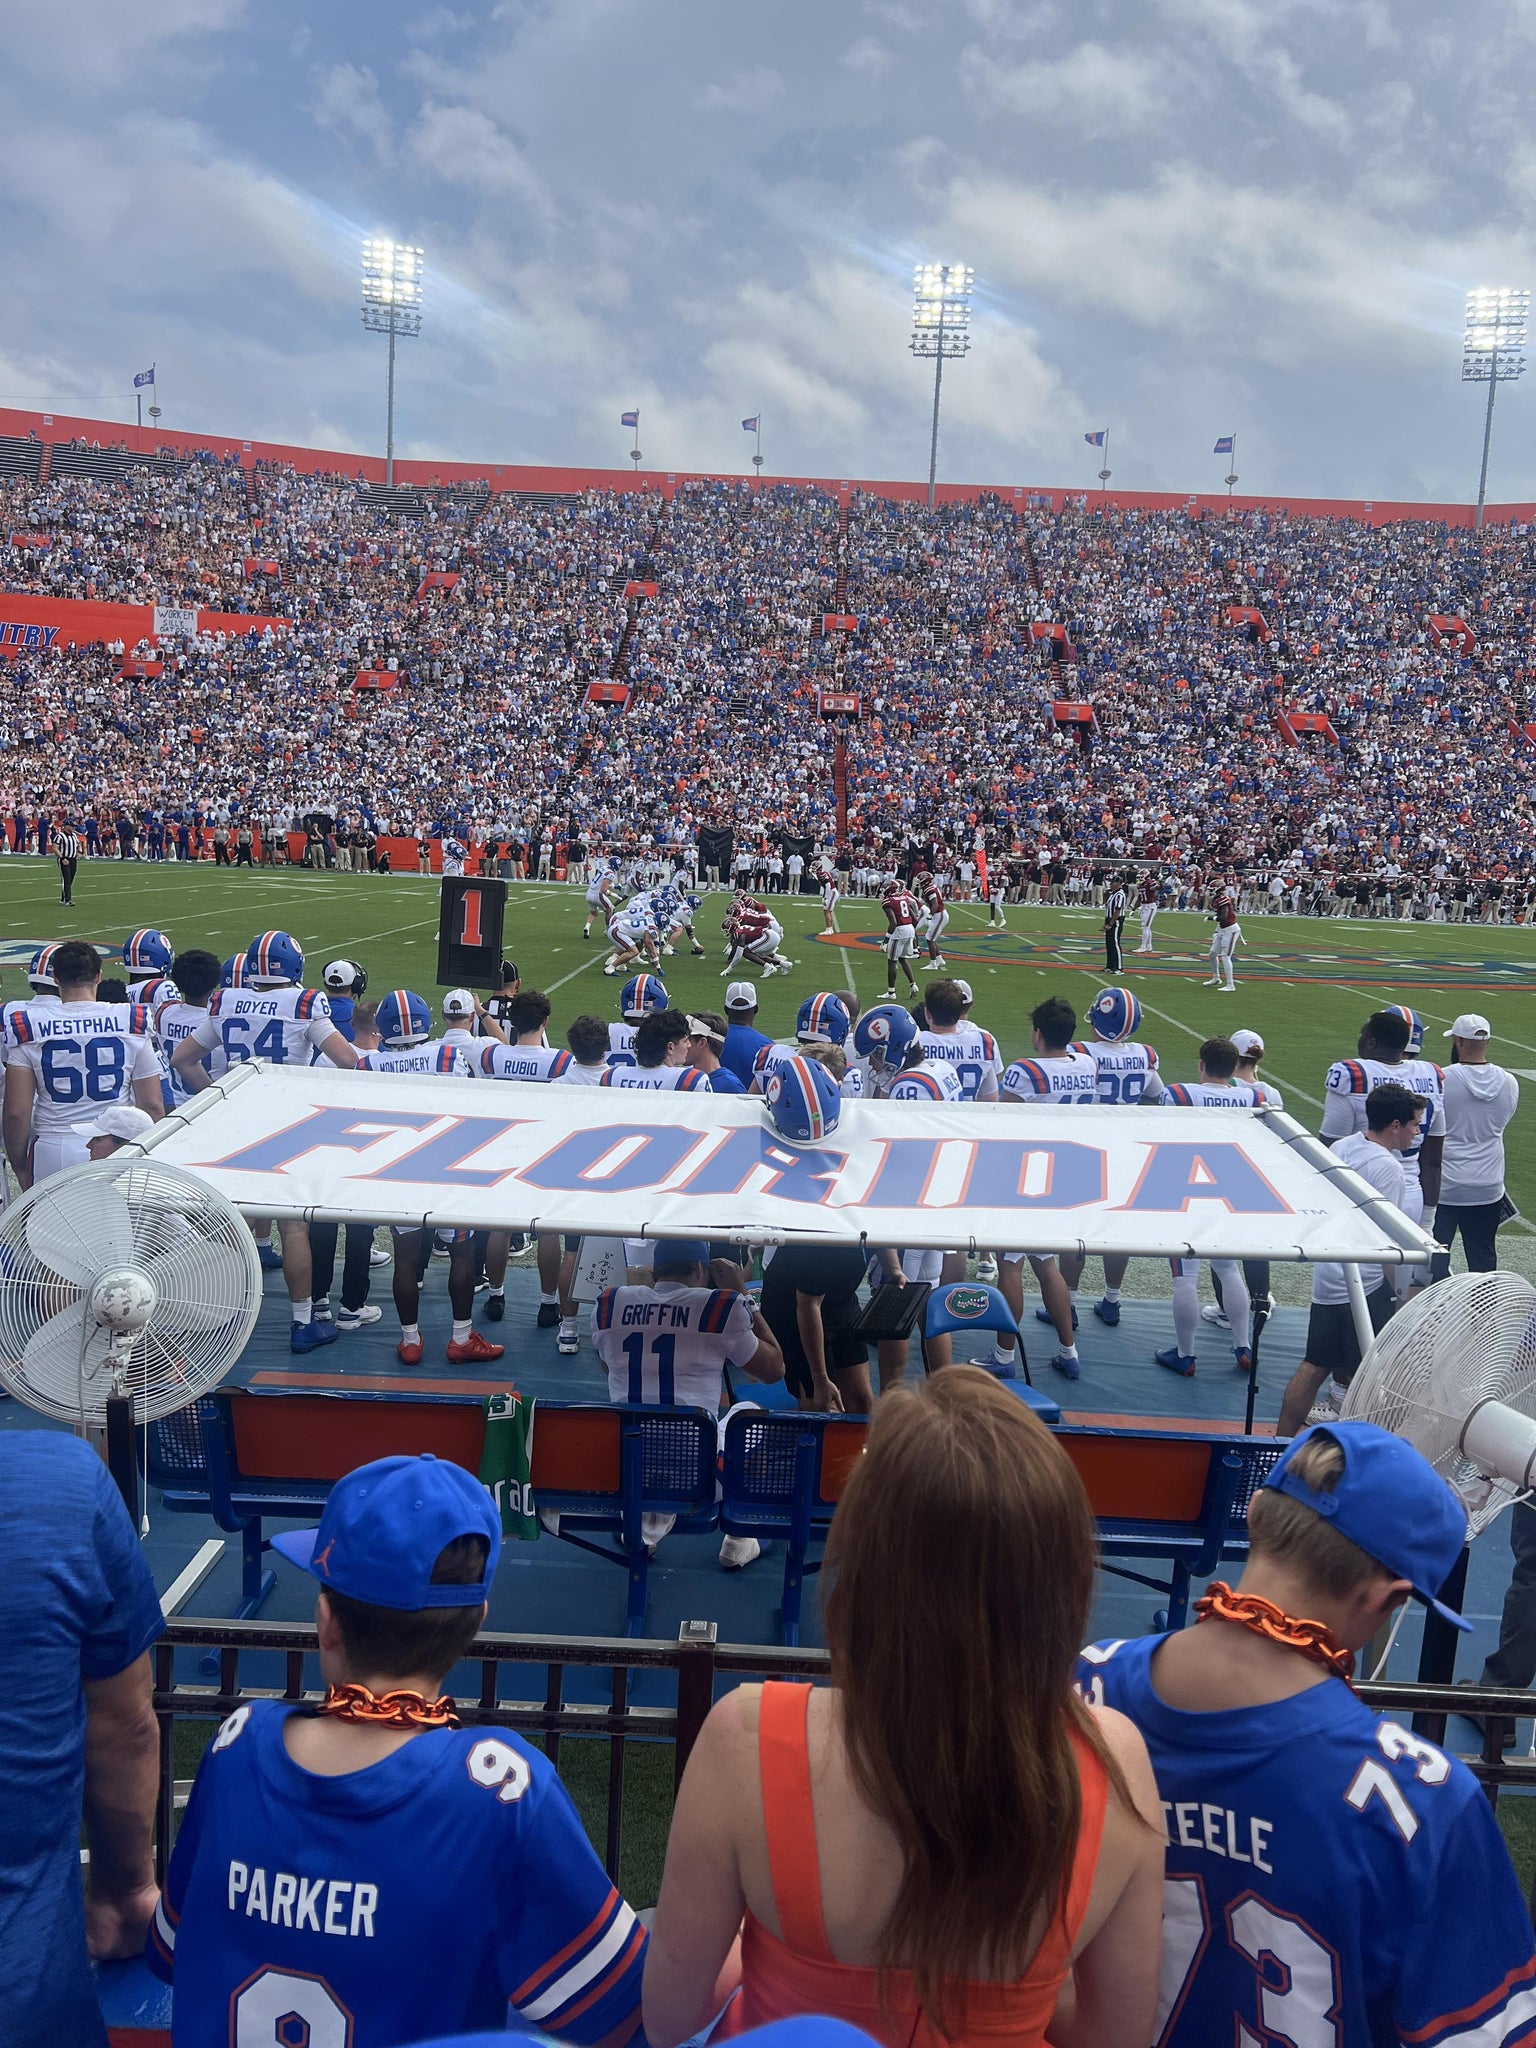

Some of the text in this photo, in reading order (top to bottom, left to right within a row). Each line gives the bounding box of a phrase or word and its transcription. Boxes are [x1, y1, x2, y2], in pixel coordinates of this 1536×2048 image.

[460, 889, 482, 947] 1
[899, 901, 910, 918] 8
[235, 1000, 278, 1016] BOYER
[38, 1016, 124, 1038] WESTPHAL
[222, 1018, 289, 1065] 64
[41, 1036, 125, 1103] 68
[503, 1060, 538, 1076] RUBIO
[923, 1045, 981, 1060] BROWN JR
[1097, 1057, 1145, 1070] MILLIRON
[896, 1086, 918, 1101] 48
[183, 1104, 1297, 1216] FLORIDA
[621, 1303, 690, 1328] GRIFFIN
[622, 1331, 676, 1406] 11
[467, 1738, 531, 1804] 9
[1344, 1720, 1452, 1848] 73
[228, 1858, 379, 1938] PARKER
